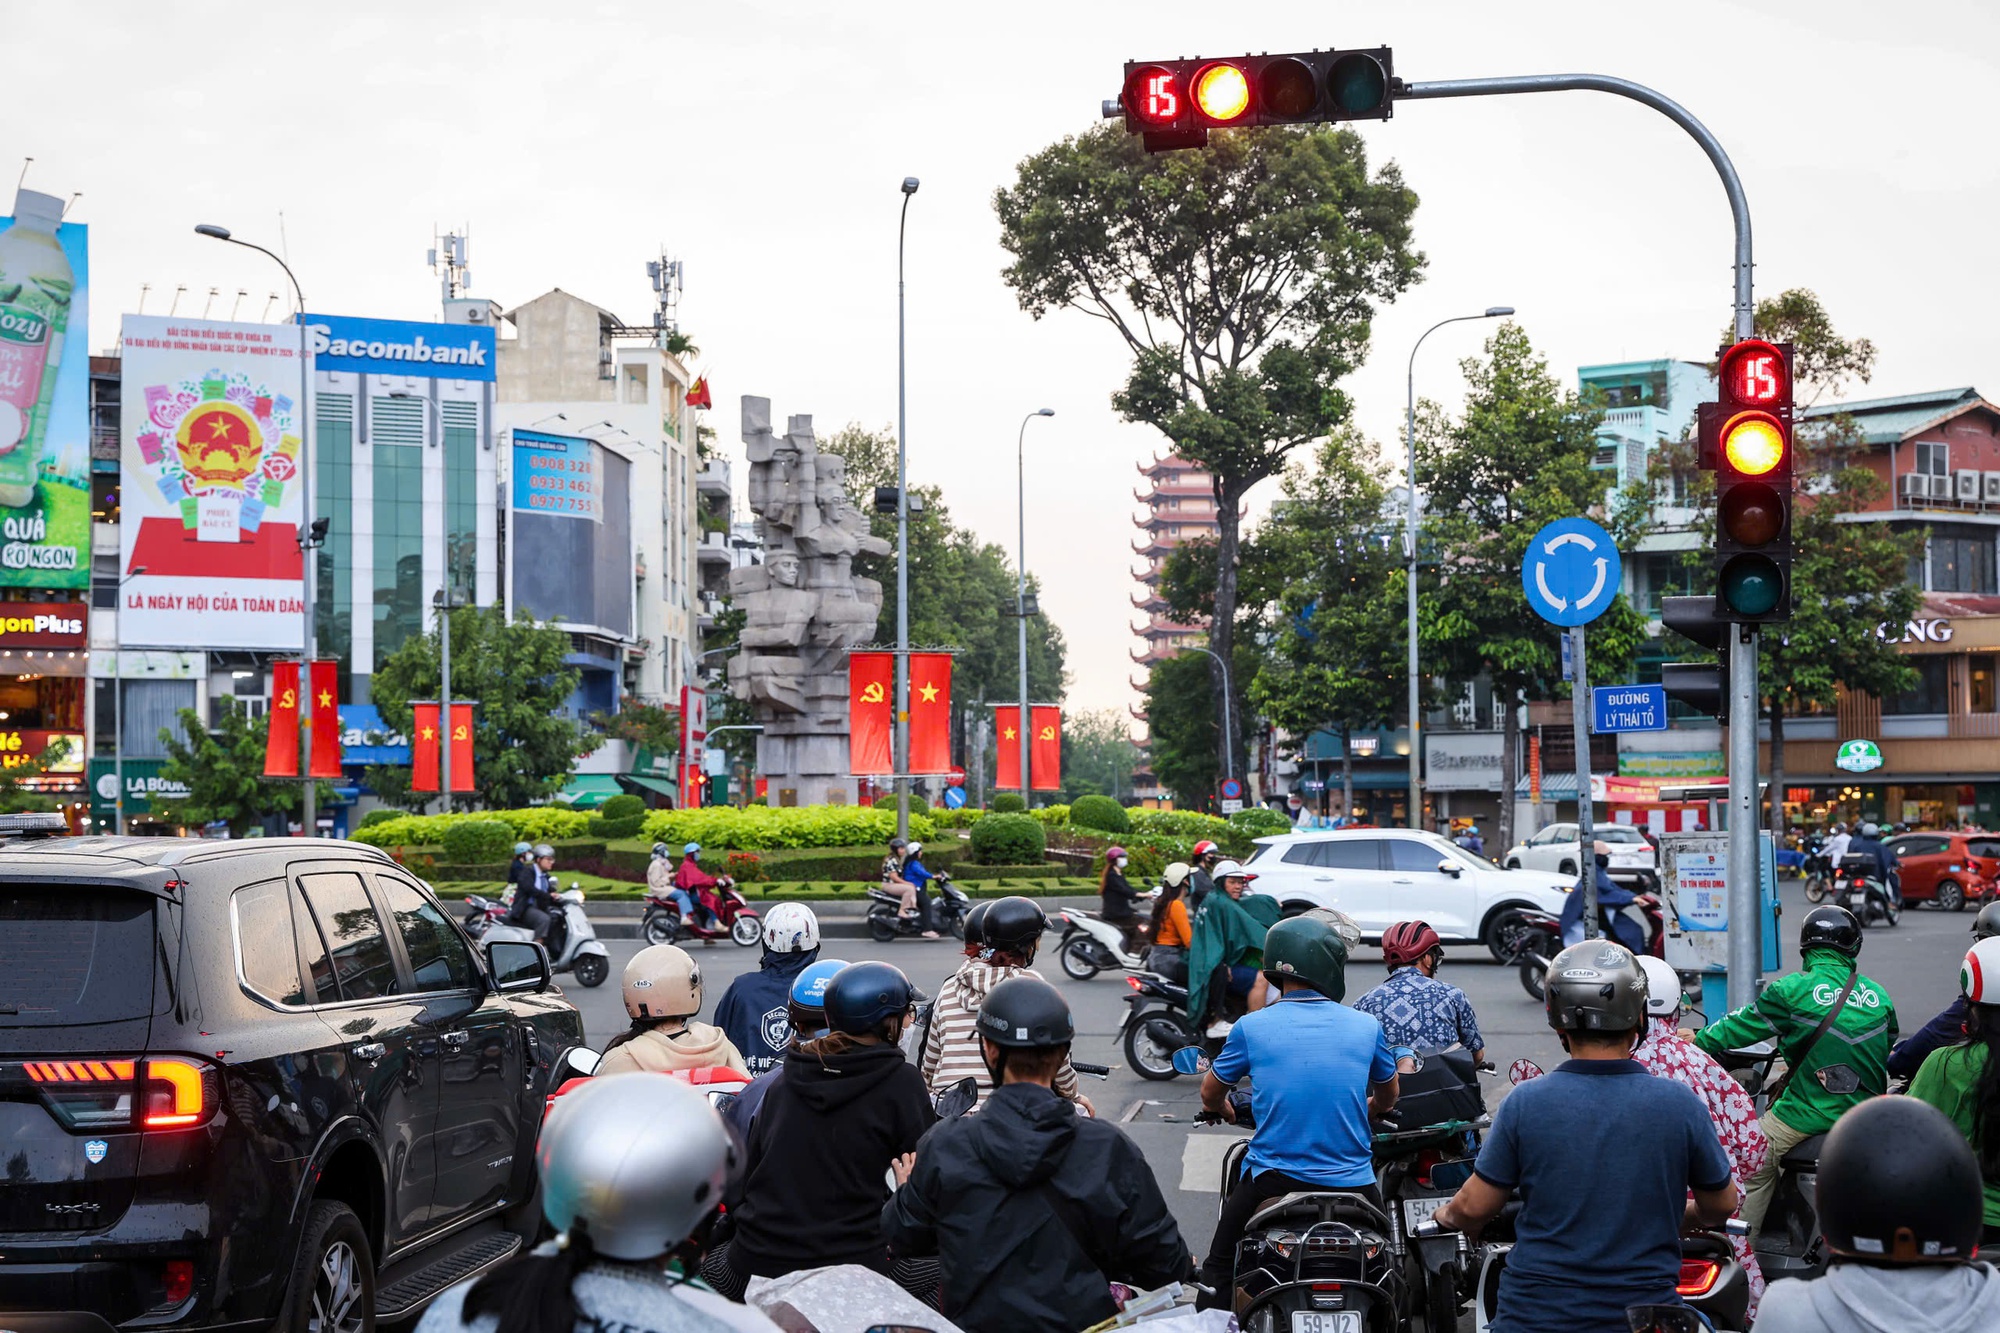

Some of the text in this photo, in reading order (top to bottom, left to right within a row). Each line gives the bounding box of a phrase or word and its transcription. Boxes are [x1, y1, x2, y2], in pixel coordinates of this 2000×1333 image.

[1149, 76, 1176, 116] 15
[0, 308, 43, 341] ozy
[314, 324, 488, 366] Sacombank
[1746, 357, 1776, 399] 15
[530, 455, 565, 471] 0908
[530, 475, 565, 490] 0933
[530, 494, 565, 509] 0977
[4, 509, 45, 541] QUẢ
[29, 546, 77, 570] NGON
[128, 592, 144, 609] LÀ
[148, 594, 182, 610] NGÀY
[187, 594, 208, 613] HỘI
[213, 592, 238, 611] CỦA
[243, 596, 275, 612] TOÀN
[1608, 691, 1650, 706] ĐƯỜNG
[1605, 705, 1655, 728] LÝ THÁI TỔ
[1812, 983, 1880, 1008] Grab
[1303, 1315, 1352, 1333] 59-V2
